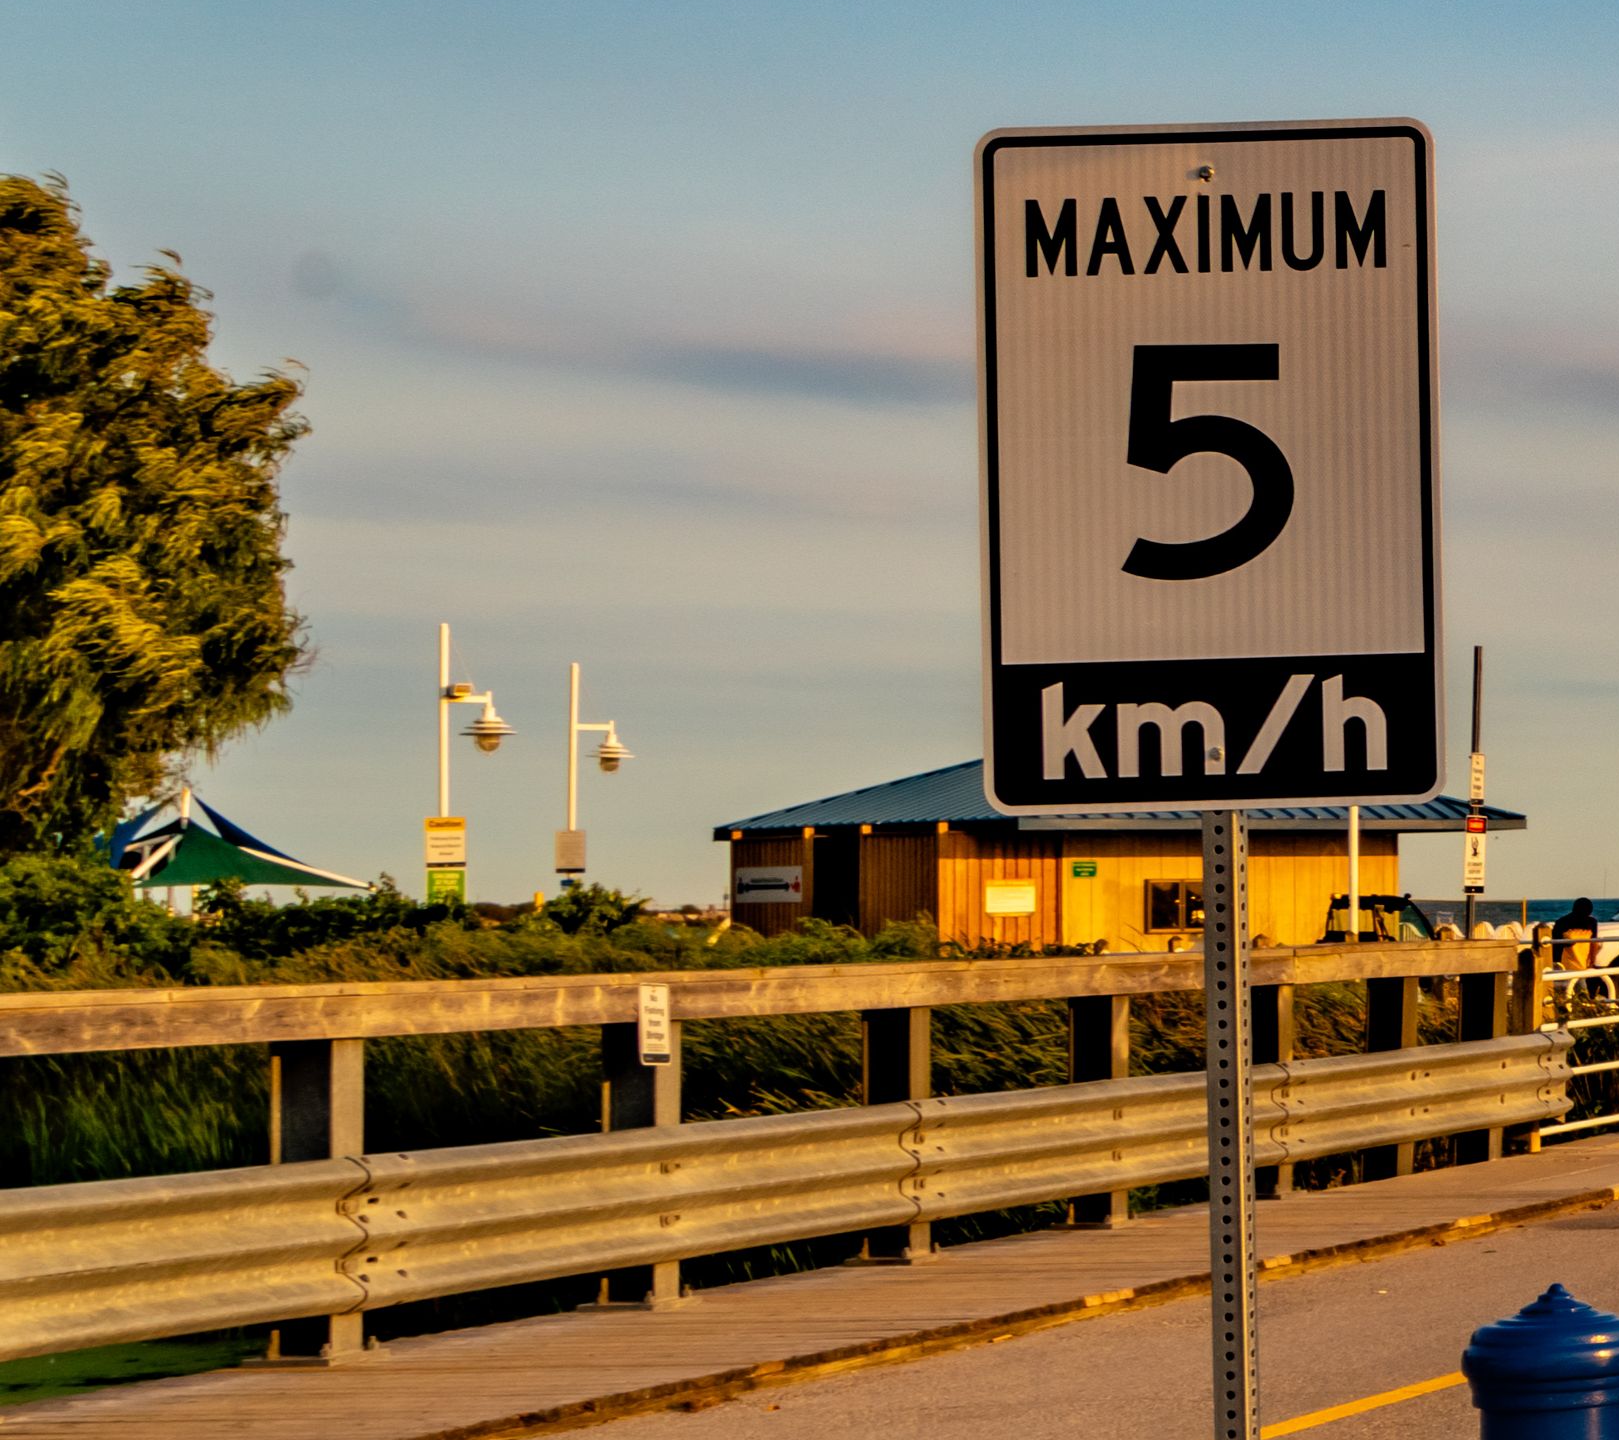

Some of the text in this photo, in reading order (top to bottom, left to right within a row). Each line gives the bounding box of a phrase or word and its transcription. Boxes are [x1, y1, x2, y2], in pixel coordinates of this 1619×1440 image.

[1025, 189, 1387, 278] MAXIMUM
[1121, 343, 1295, 581] 5
[1041, 674, 1387, 780] km/h
